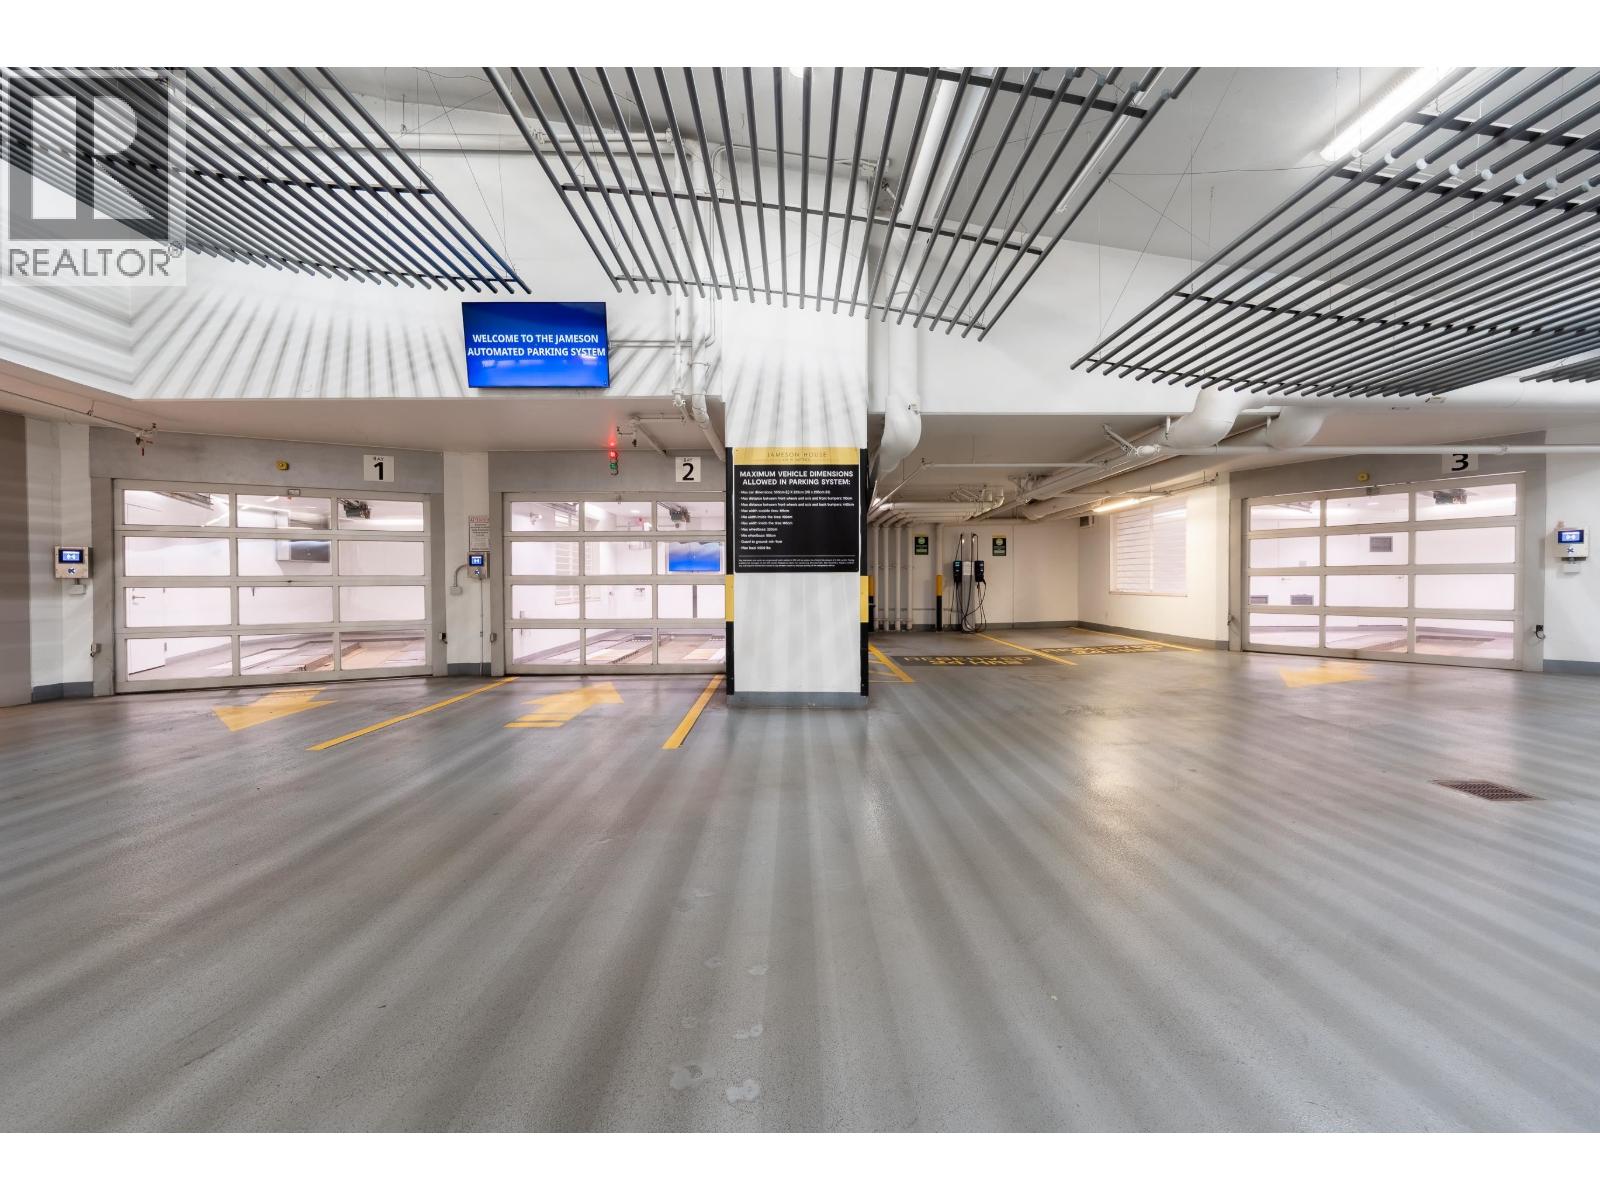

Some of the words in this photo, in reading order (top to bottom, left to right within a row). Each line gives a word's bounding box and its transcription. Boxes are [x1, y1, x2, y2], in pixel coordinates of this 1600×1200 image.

[472, 334, 519, 343] WELCOME
[520, 334, 533, 343] TO
[535, 334, 554, 343] THE
[555, 334, 599, 345] JAMESON
[467, 347, 525, 356] AUTOMATED
[527, 347, 569, 356] PARKING
[570, 347, 606, 356] SYSTEM
[1451, 454, 1468, 471] 3
[373, 461, 384, 480] 1
[682, 462, 694, 481] 2
[740, 470, 776, 478] MAXIMUM
[778, 470, 808, 478] VEHICLE
[809, 470, 854, 478] DIMENSIONS
[742, 478, 778, 486] ALLOWED
[779, 478, 787, 486] IN
[788, 478, 819, 486] PARKING
[821, 478, 851, 486] SYSTEM:
